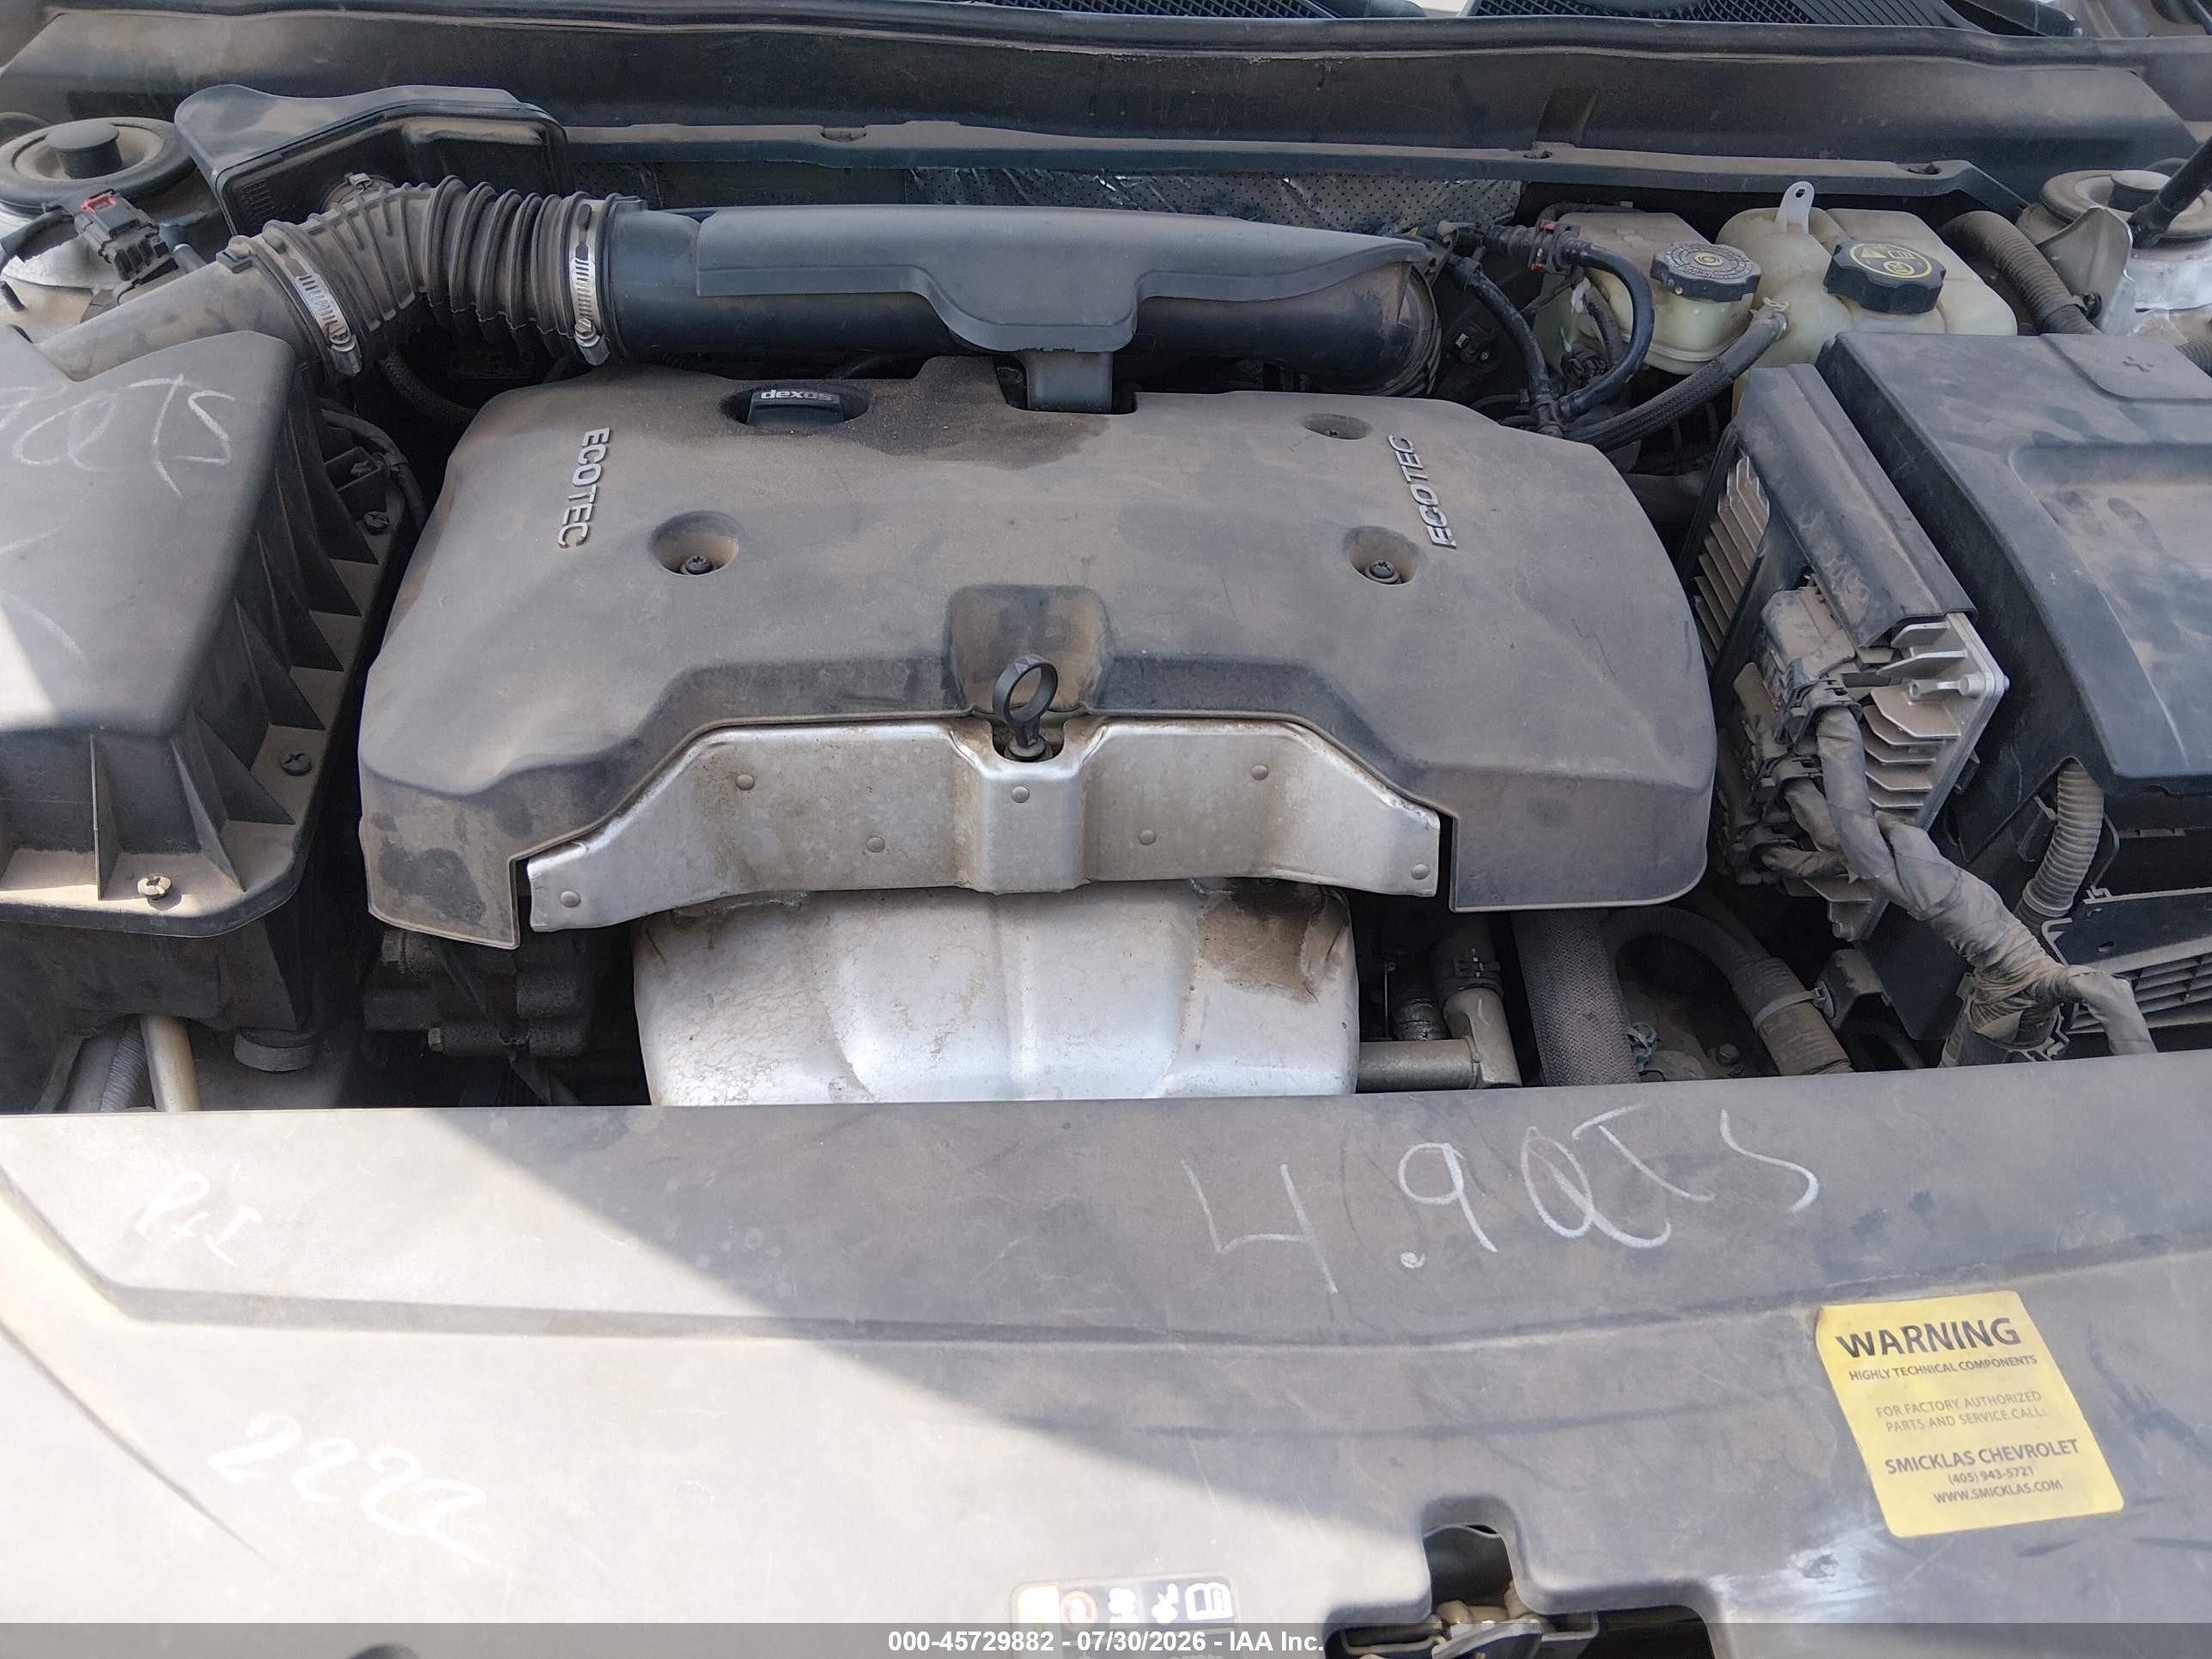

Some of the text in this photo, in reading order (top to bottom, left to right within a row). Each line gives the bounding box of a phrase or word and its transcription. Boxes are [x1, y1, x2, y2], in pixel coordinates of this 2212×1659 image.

[760, 389, 832, 401] dexos
[558, 427, 611, 549] ECOTEC
[1388, 434, 1457, 550] ECOTEC
[1834, 1317, 2022, 1358] WARNING
[1848, 1355, 2039, 1382] HIGHLY TECHNICAL COMPONENTS
[1875, 1390, 2042, 1418] FOR FACTORY AUTHORIZED
[1885, 1406, 2048, 1433] PARTS AND SERVICE CALL:
[1884, 1438, 2081, 1474] SMICKLAS CHEVROLET
[1948, 1466, 2035, 1486] (405) 943-5721
[1933, 1479, 2063, 1504] WWW.SMICKLAS.COM
